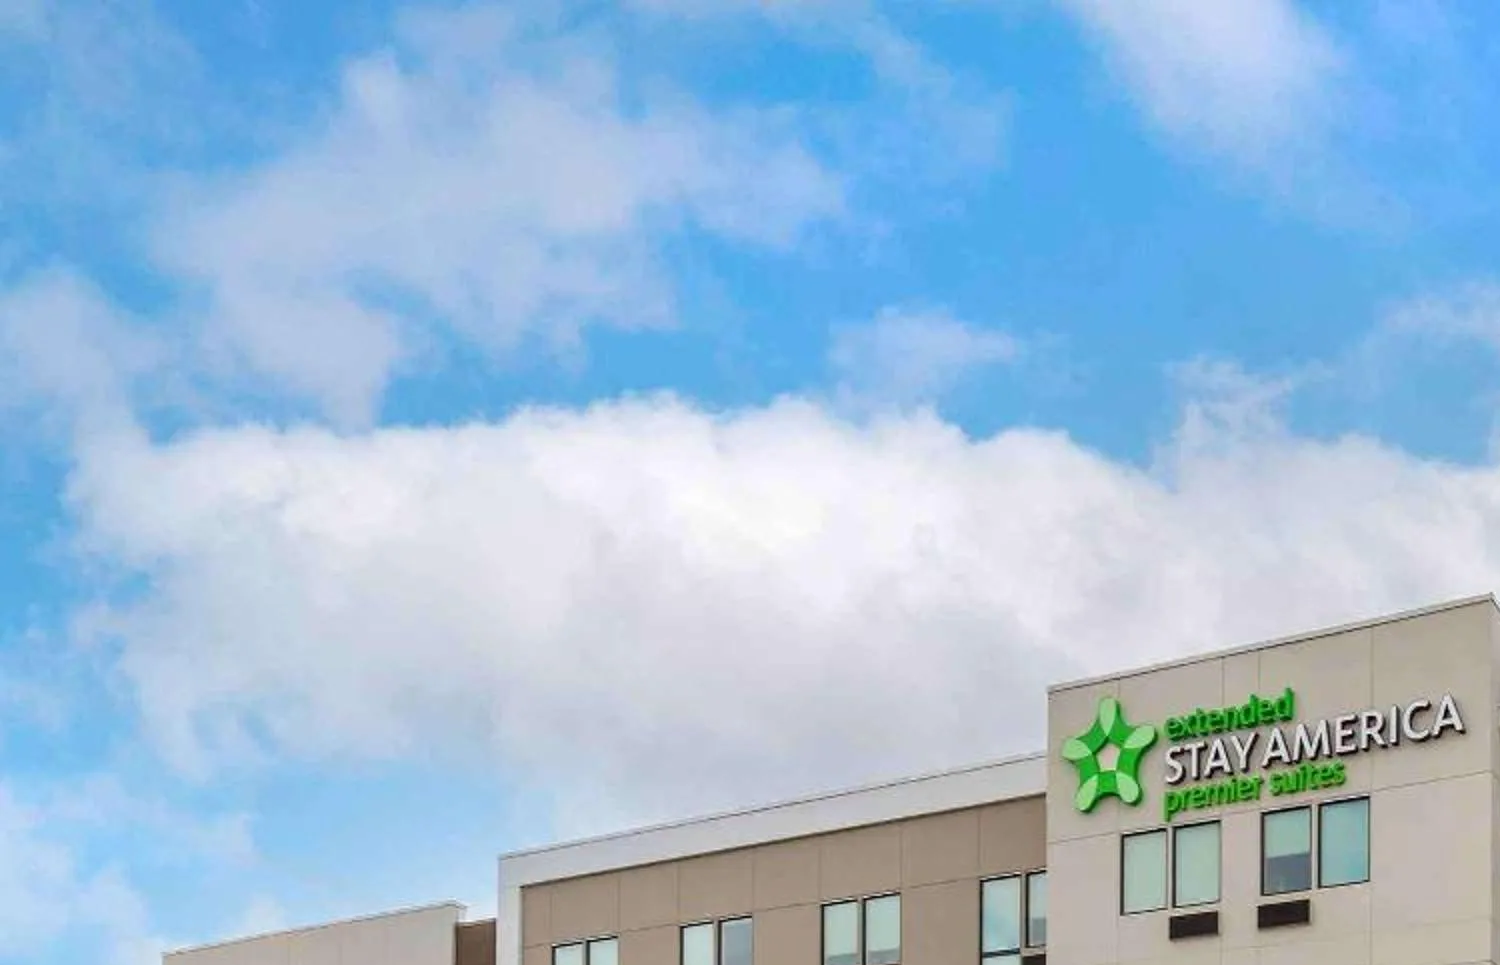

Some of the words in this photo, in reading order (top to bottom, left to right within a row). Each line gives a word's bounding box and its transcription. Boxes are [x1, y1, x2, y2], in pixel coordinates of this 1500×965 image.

[1164, 687, 1295, 741] extended
[1165, 731, 1259, 785] STAY
[1262, 693, 1466, 769] AMERICA
[1163, 774, 1264, 822] premier
[1268, 759, 1346, 796] suites
